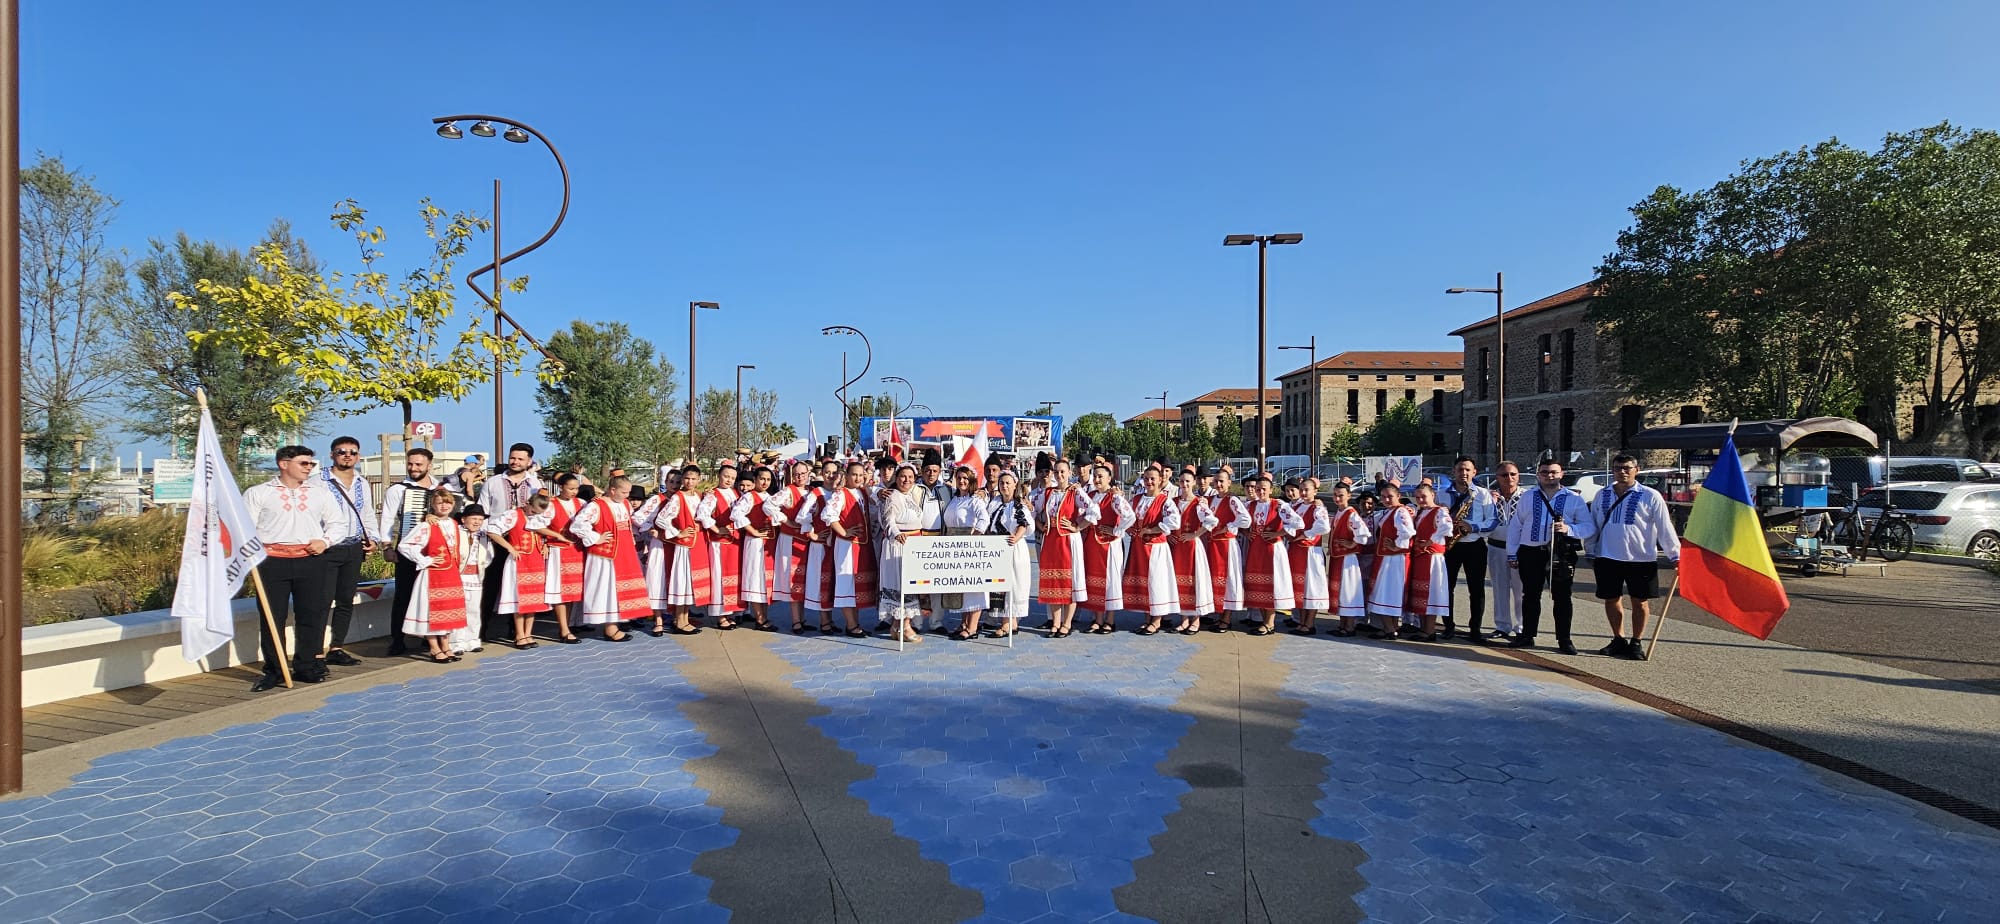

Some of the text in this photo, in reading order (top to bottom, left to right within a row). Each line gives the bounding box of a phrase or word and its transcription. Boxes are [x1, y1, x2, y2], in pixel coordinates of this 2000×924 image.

[932, 541, 985, 549] ANSAMBLUL
[923, 562, 962, 570] COMUNA
[933, 575, 983, 586] ROMÂNIA
